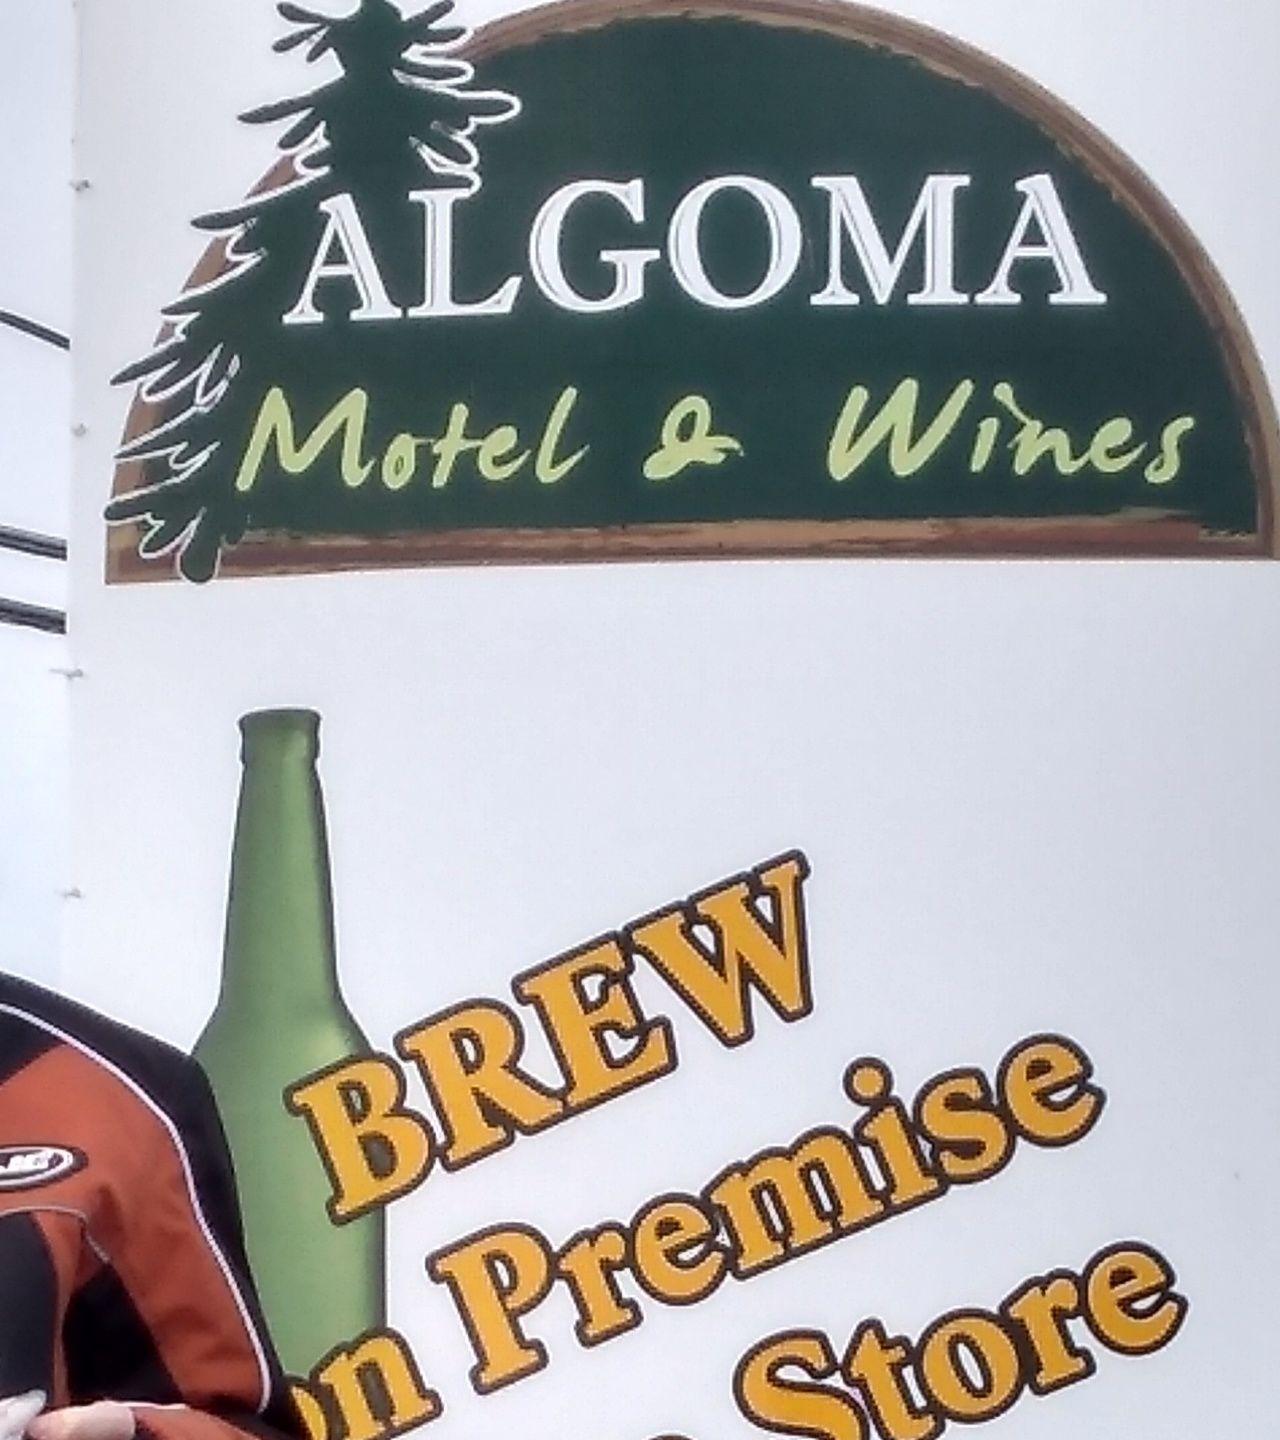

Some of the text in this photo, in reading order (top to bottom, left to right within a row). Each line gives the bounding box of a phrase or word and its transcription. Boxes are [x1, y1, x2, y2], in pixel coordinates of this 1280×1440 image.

[281, 171, 1107, 324] ALGOMA
[234, 378, 1198, 491] Motel & Wines
[284, 849, 814, 1225] BREW
[427, 1032, 1106, 1395] Premise
